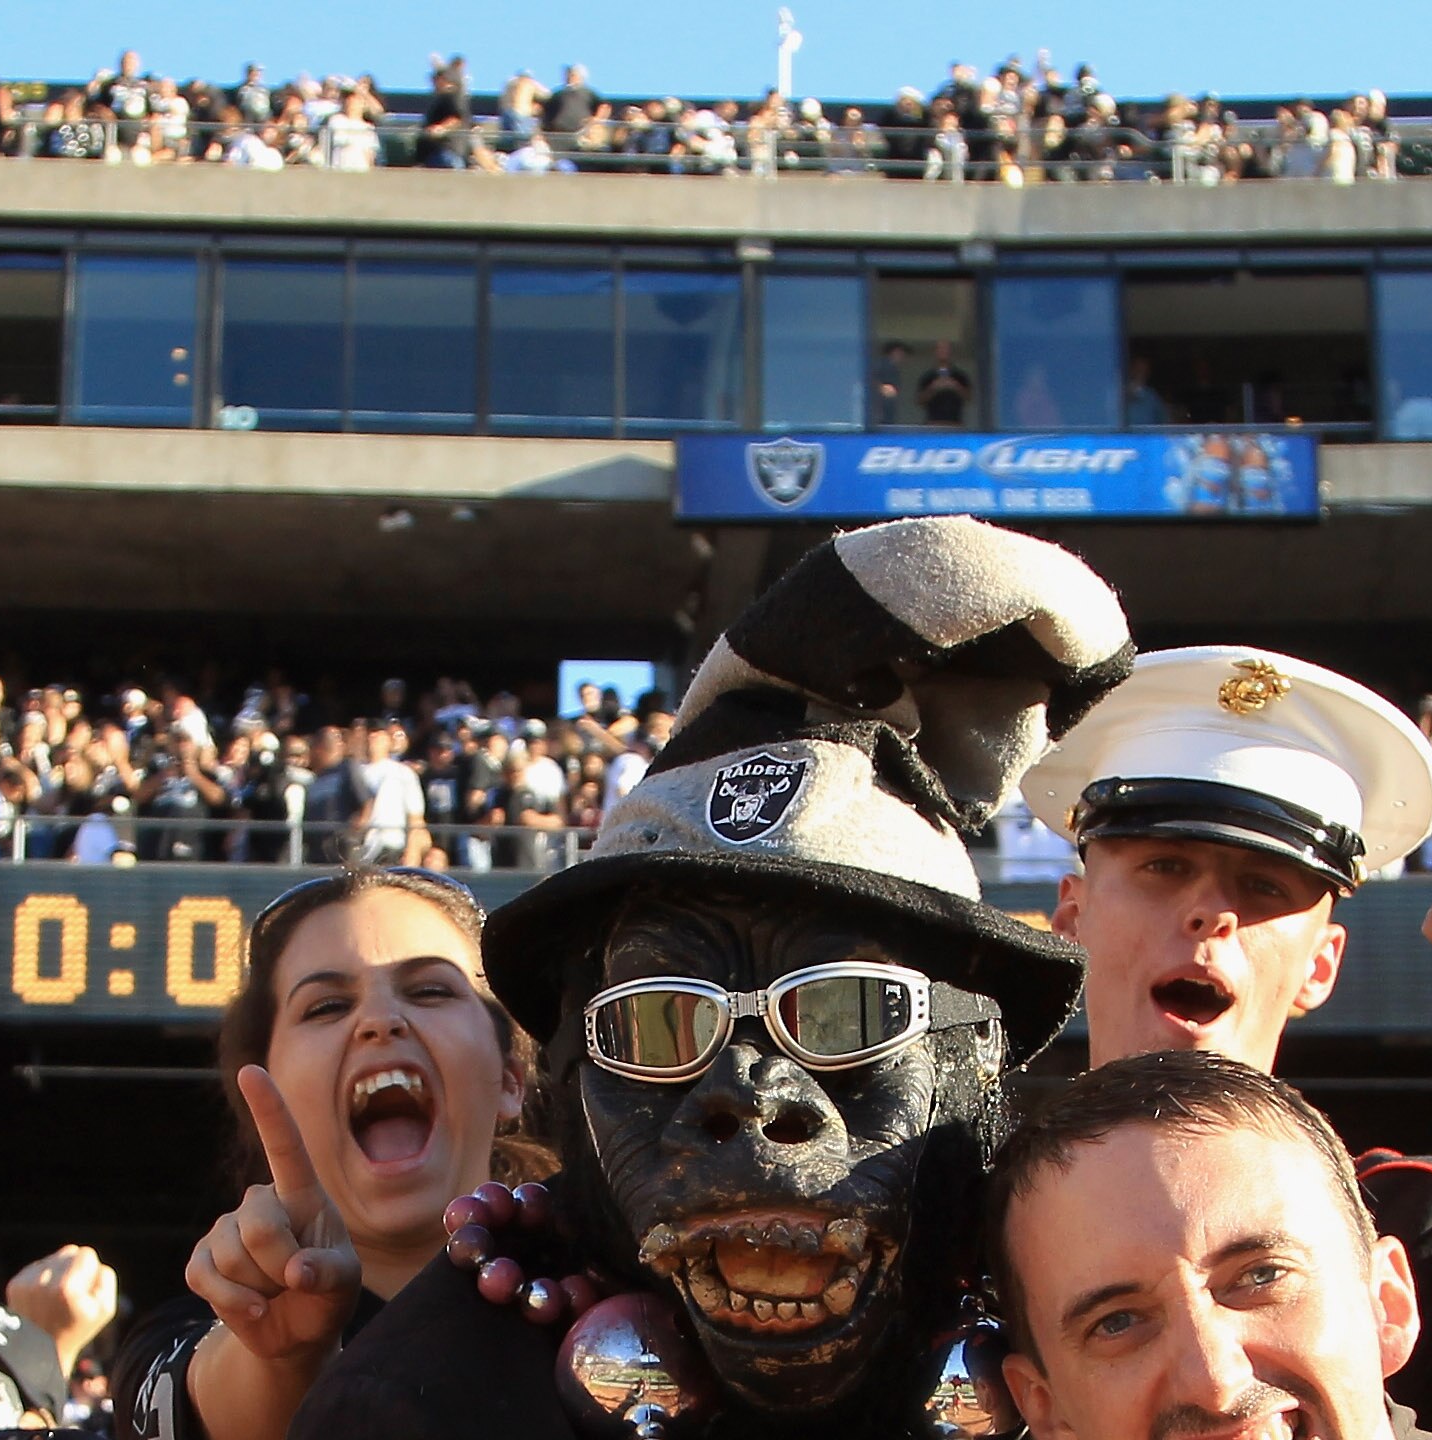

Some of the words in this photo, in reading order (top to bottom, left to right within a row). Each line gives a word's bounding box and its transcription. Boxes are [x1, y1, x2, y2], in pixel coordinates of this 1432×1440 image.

[857, 446, 973, 475] BUD
[992, 446, 1139, 475] LIGHT
[720, 762, 800, 781] RAIDERS
